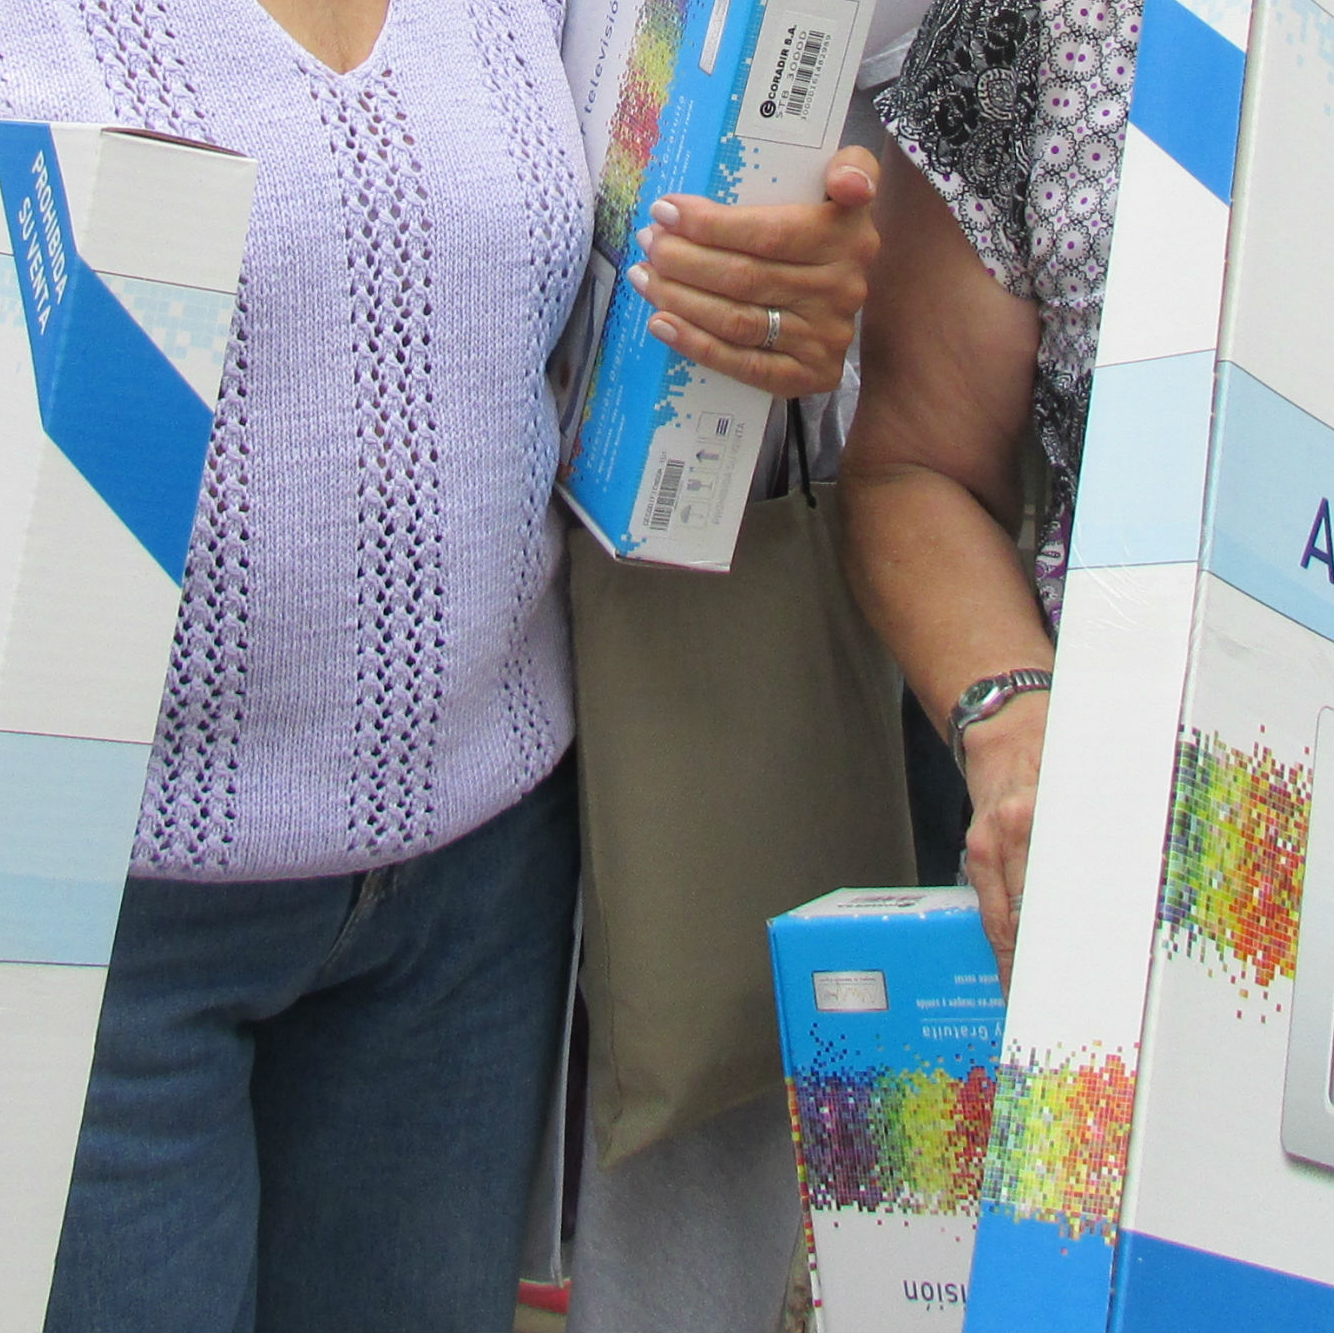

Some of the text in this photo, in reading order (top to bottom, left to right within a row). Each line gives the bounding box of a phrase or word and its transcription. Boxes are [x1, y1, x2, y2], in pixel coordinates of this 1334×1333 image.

[768, 24, 798, 100] CORADIR S.A.
[775, 89, 790, 120] STB
[18, 196, 52, 336] SU VENTA
[31, 149, 68, 305] PROHIBIDA
